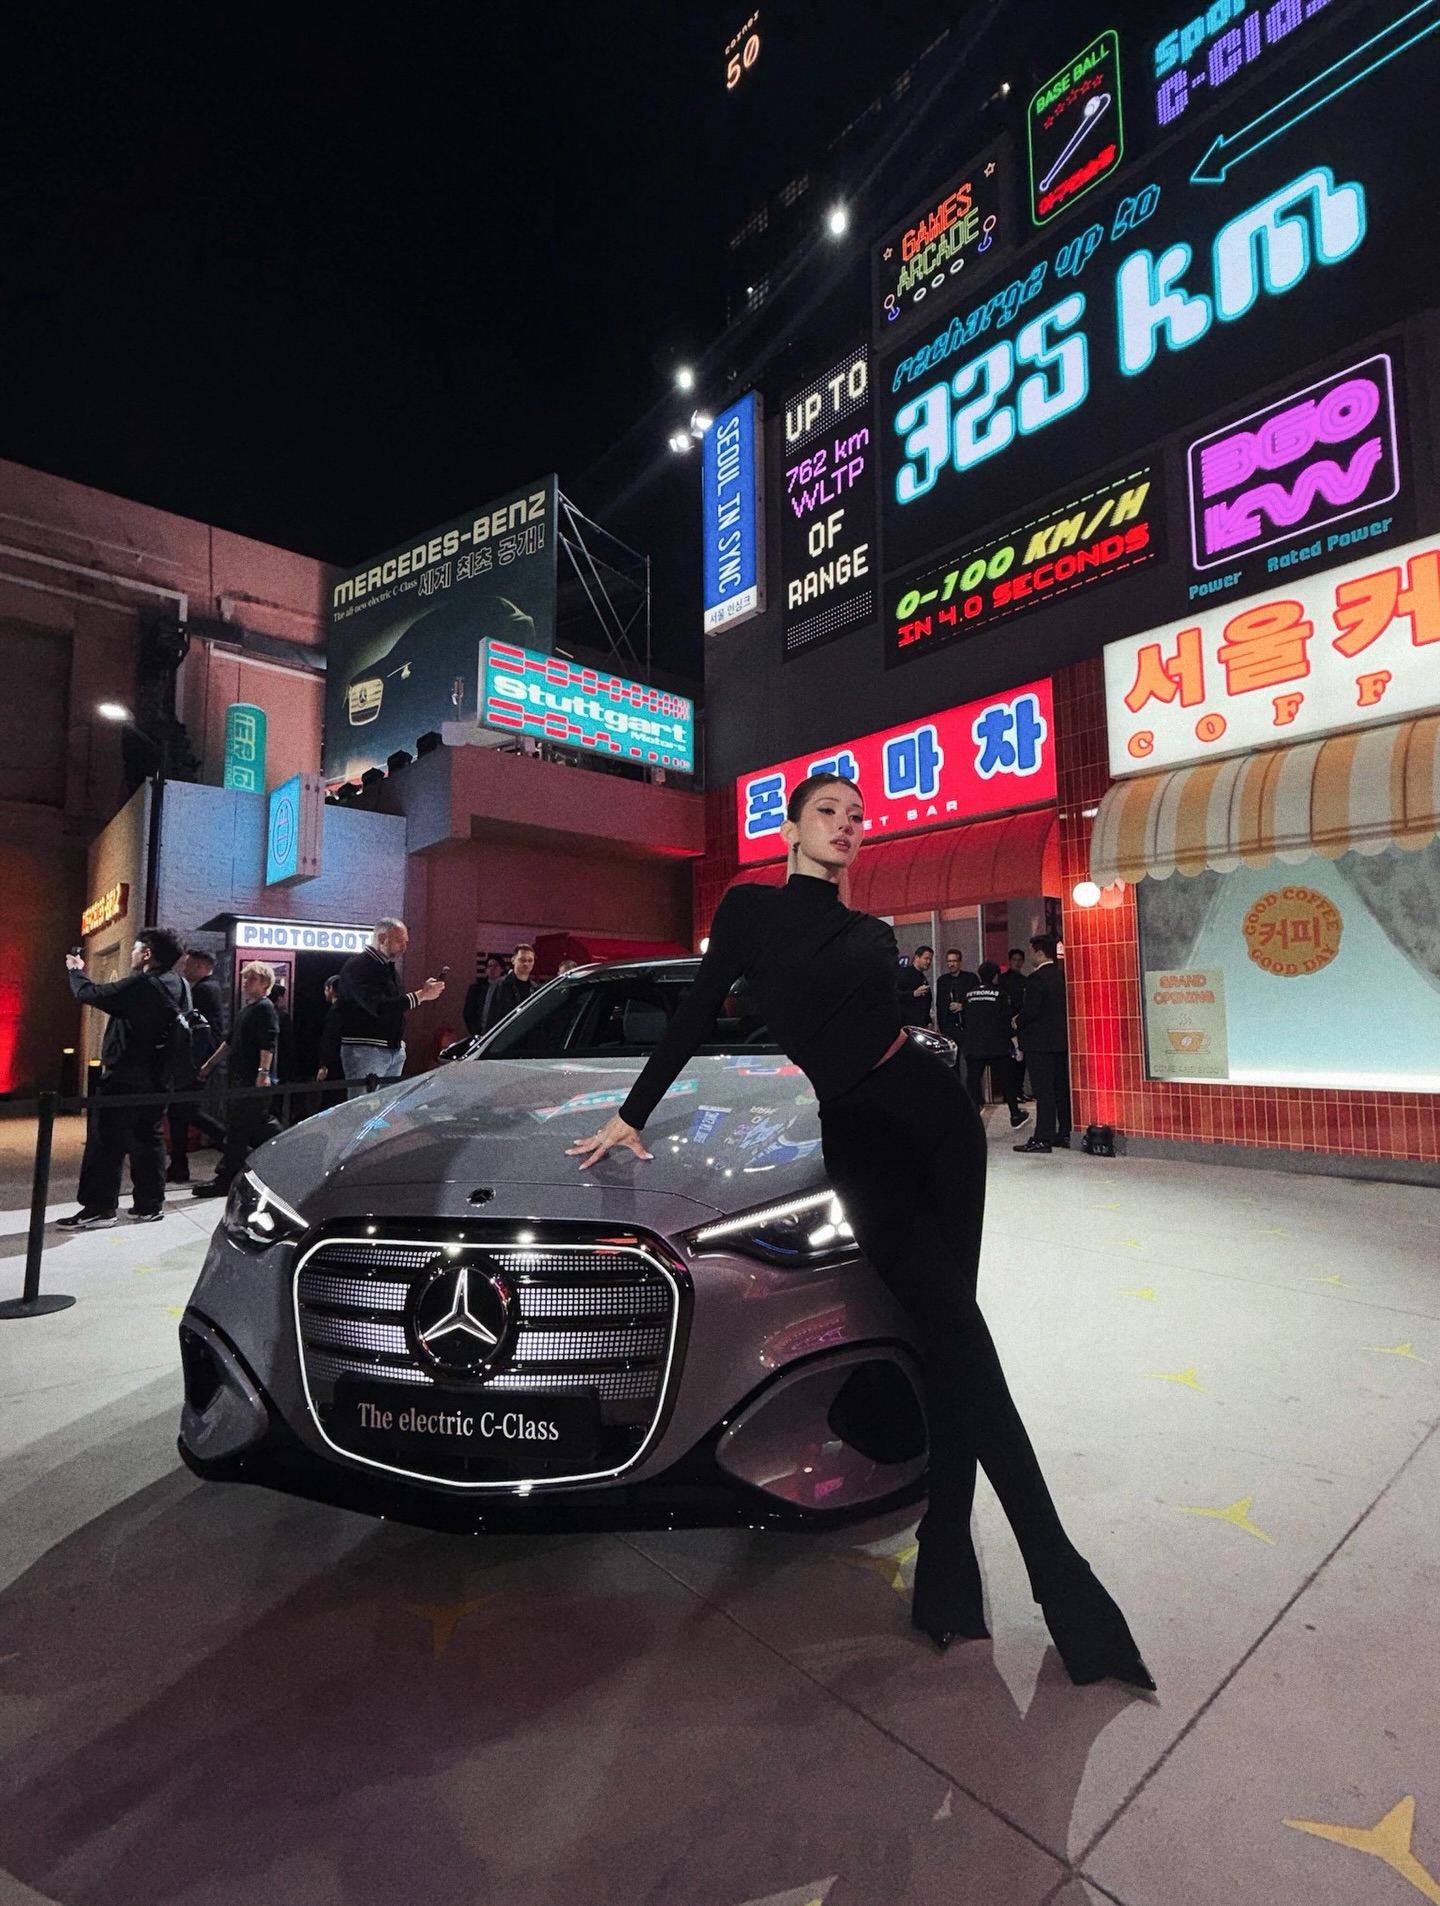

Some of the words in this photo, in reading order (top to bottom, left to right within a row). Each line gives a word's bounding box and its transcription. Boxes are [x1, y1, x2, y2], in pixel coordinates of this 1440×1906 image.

[727, 34, 760, 89] 50
[1036, 72, 1071, 114] BASE
[1073, 44, 1110, 82] BALL
[1156, 0, 1331, 126] C-Cla
[897, 206, 980, 297] ARCADE
[902, 183, 972, 261] GAMES
[892, 261, 1048, 391] recharge
[1055, 224, 1104, 279] up
[1110, 183, 1161, 241] to
[895, 292, 1089, 505] 325
[1116, 165, 1366, 377] km
[785, 391, 822, 442] UP
[828, 359, 867, 411] TO
[716, 416, 740, 496] SEOUL
[785, 449, 828, 493] 762
[834, 427, 870, 464] km
[1200, 379, 1380, 499] 360
[717, 492, 741, 532] IN
[791, 456, 865, 519] WLTP
[333, 490, 546, 608] MERCEDES-BENZ
[417, 561, 452, 596] 세계
[456, 547, 492, 582] 최초
[498, 523, 545, 566] 공개!
[718, 530, 742, 594] SYNC
[808, 508, 845, 558] OF
[895, 546, 1015, 620] 0-100
[1021, 481, 1151, 566] KM/H
[1188, 570, 1242, 600] Power
[1267, 541, 1322, 573] Rated
[1327, 517, 1393, 551] Power
[333, 612, 345, 623] The
[367, 591, 392, 607] electric
[392, 579, 418, 596] C-Class
[788, 543, 869, 610] RANGE
[898, 615, 932, 648] IN
[938, 594, 984, 626] 4.0
[992, 522, 1150, 608] SECONDS
[709, 605, 725, 624] 서울
[493, 675, 687, 744] Stuttgart
[630, 731, 687, 752] Motors
[906, 800, 960, 821] BAR
[243, 925, 371, 949] PHOTOBOOT
[1245, 894, 1277, 936] GOOD
[1283, 889, 1340, 931] COFFEE
[1259, 917, 1321, 950] 커피
[1251, 948, 1298, 975] GOOD
[1303, 943, 1336, 972] DAY
[357, 1402, 393, 1430] The
[399, 1407, 473, 1437] electric
[480, 1411, 560, 1441] C-Class
